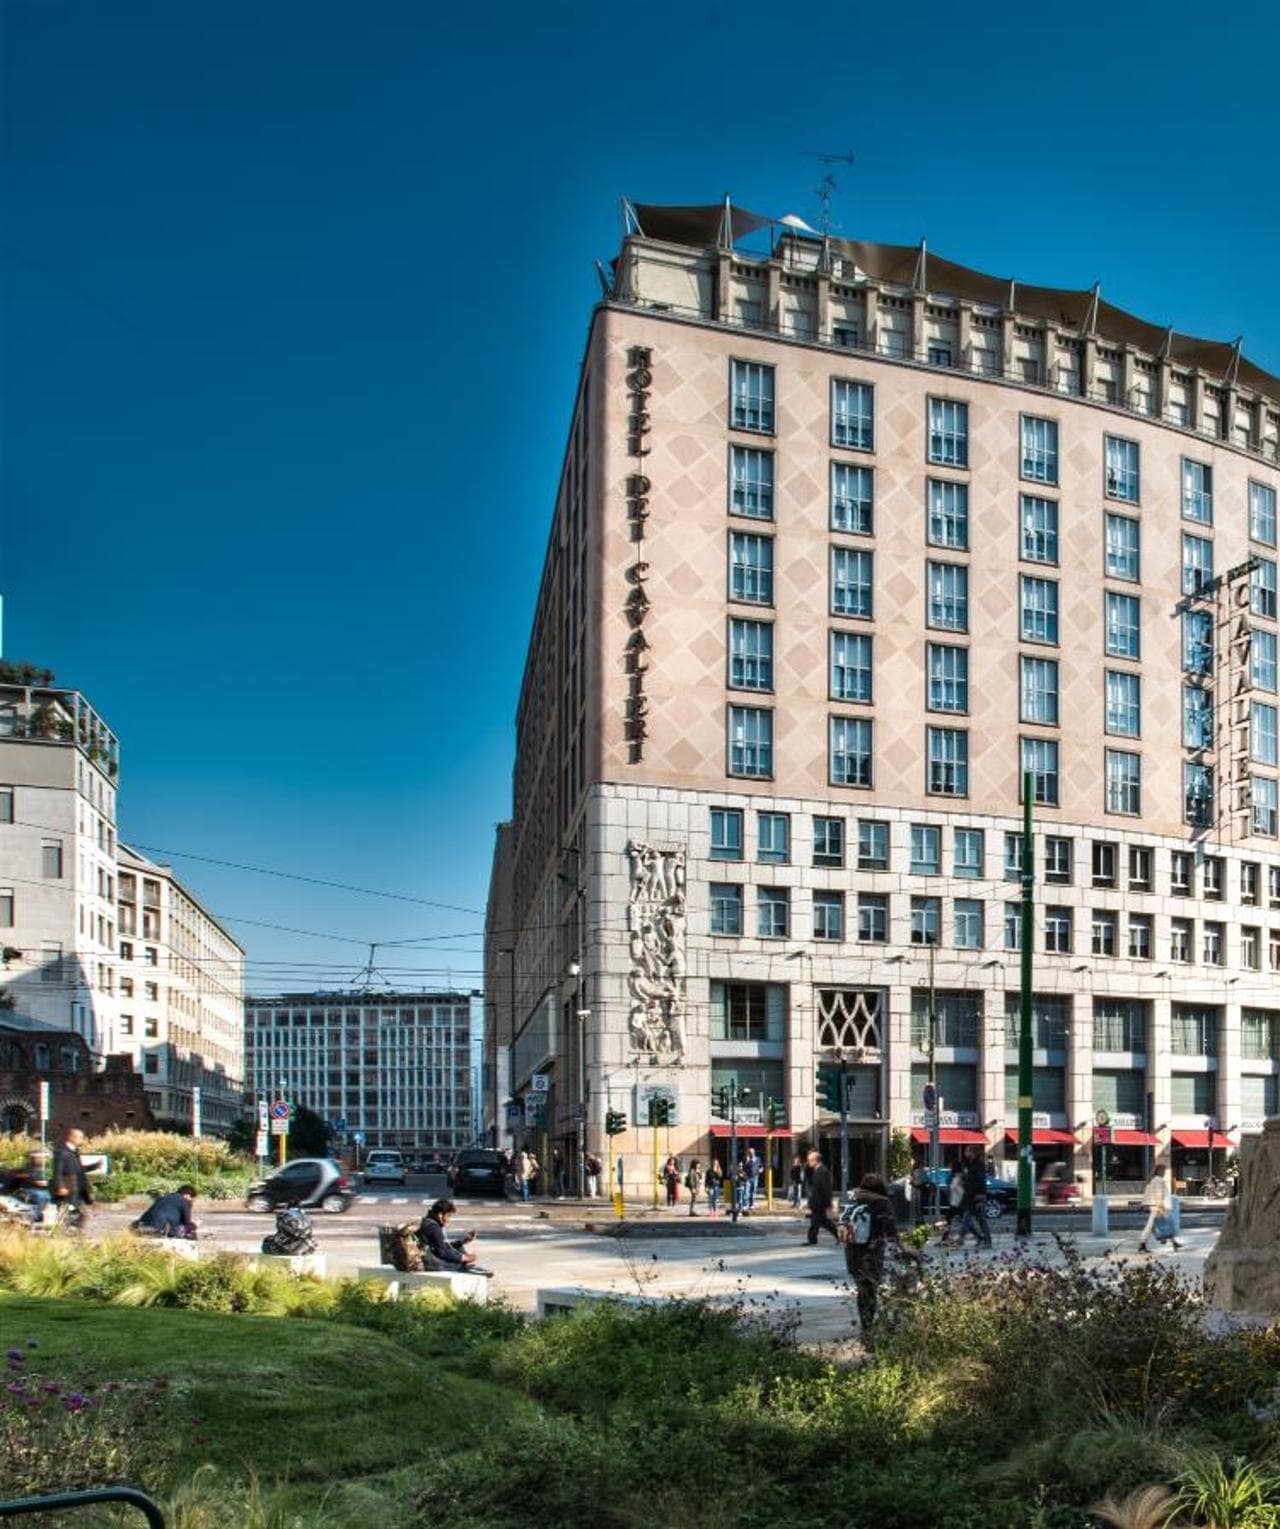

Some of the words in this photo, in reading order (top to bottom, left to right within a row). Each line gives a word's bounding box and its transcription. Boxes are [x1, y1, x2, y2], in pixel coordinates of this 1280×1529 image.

[625, 345, 654, 457] HOTEL
[625, 473, 651, 543] DEI
[623, 561, 651, 765] CAVALIERI
[1231, 582, 1251, 841] CAVALIERI
